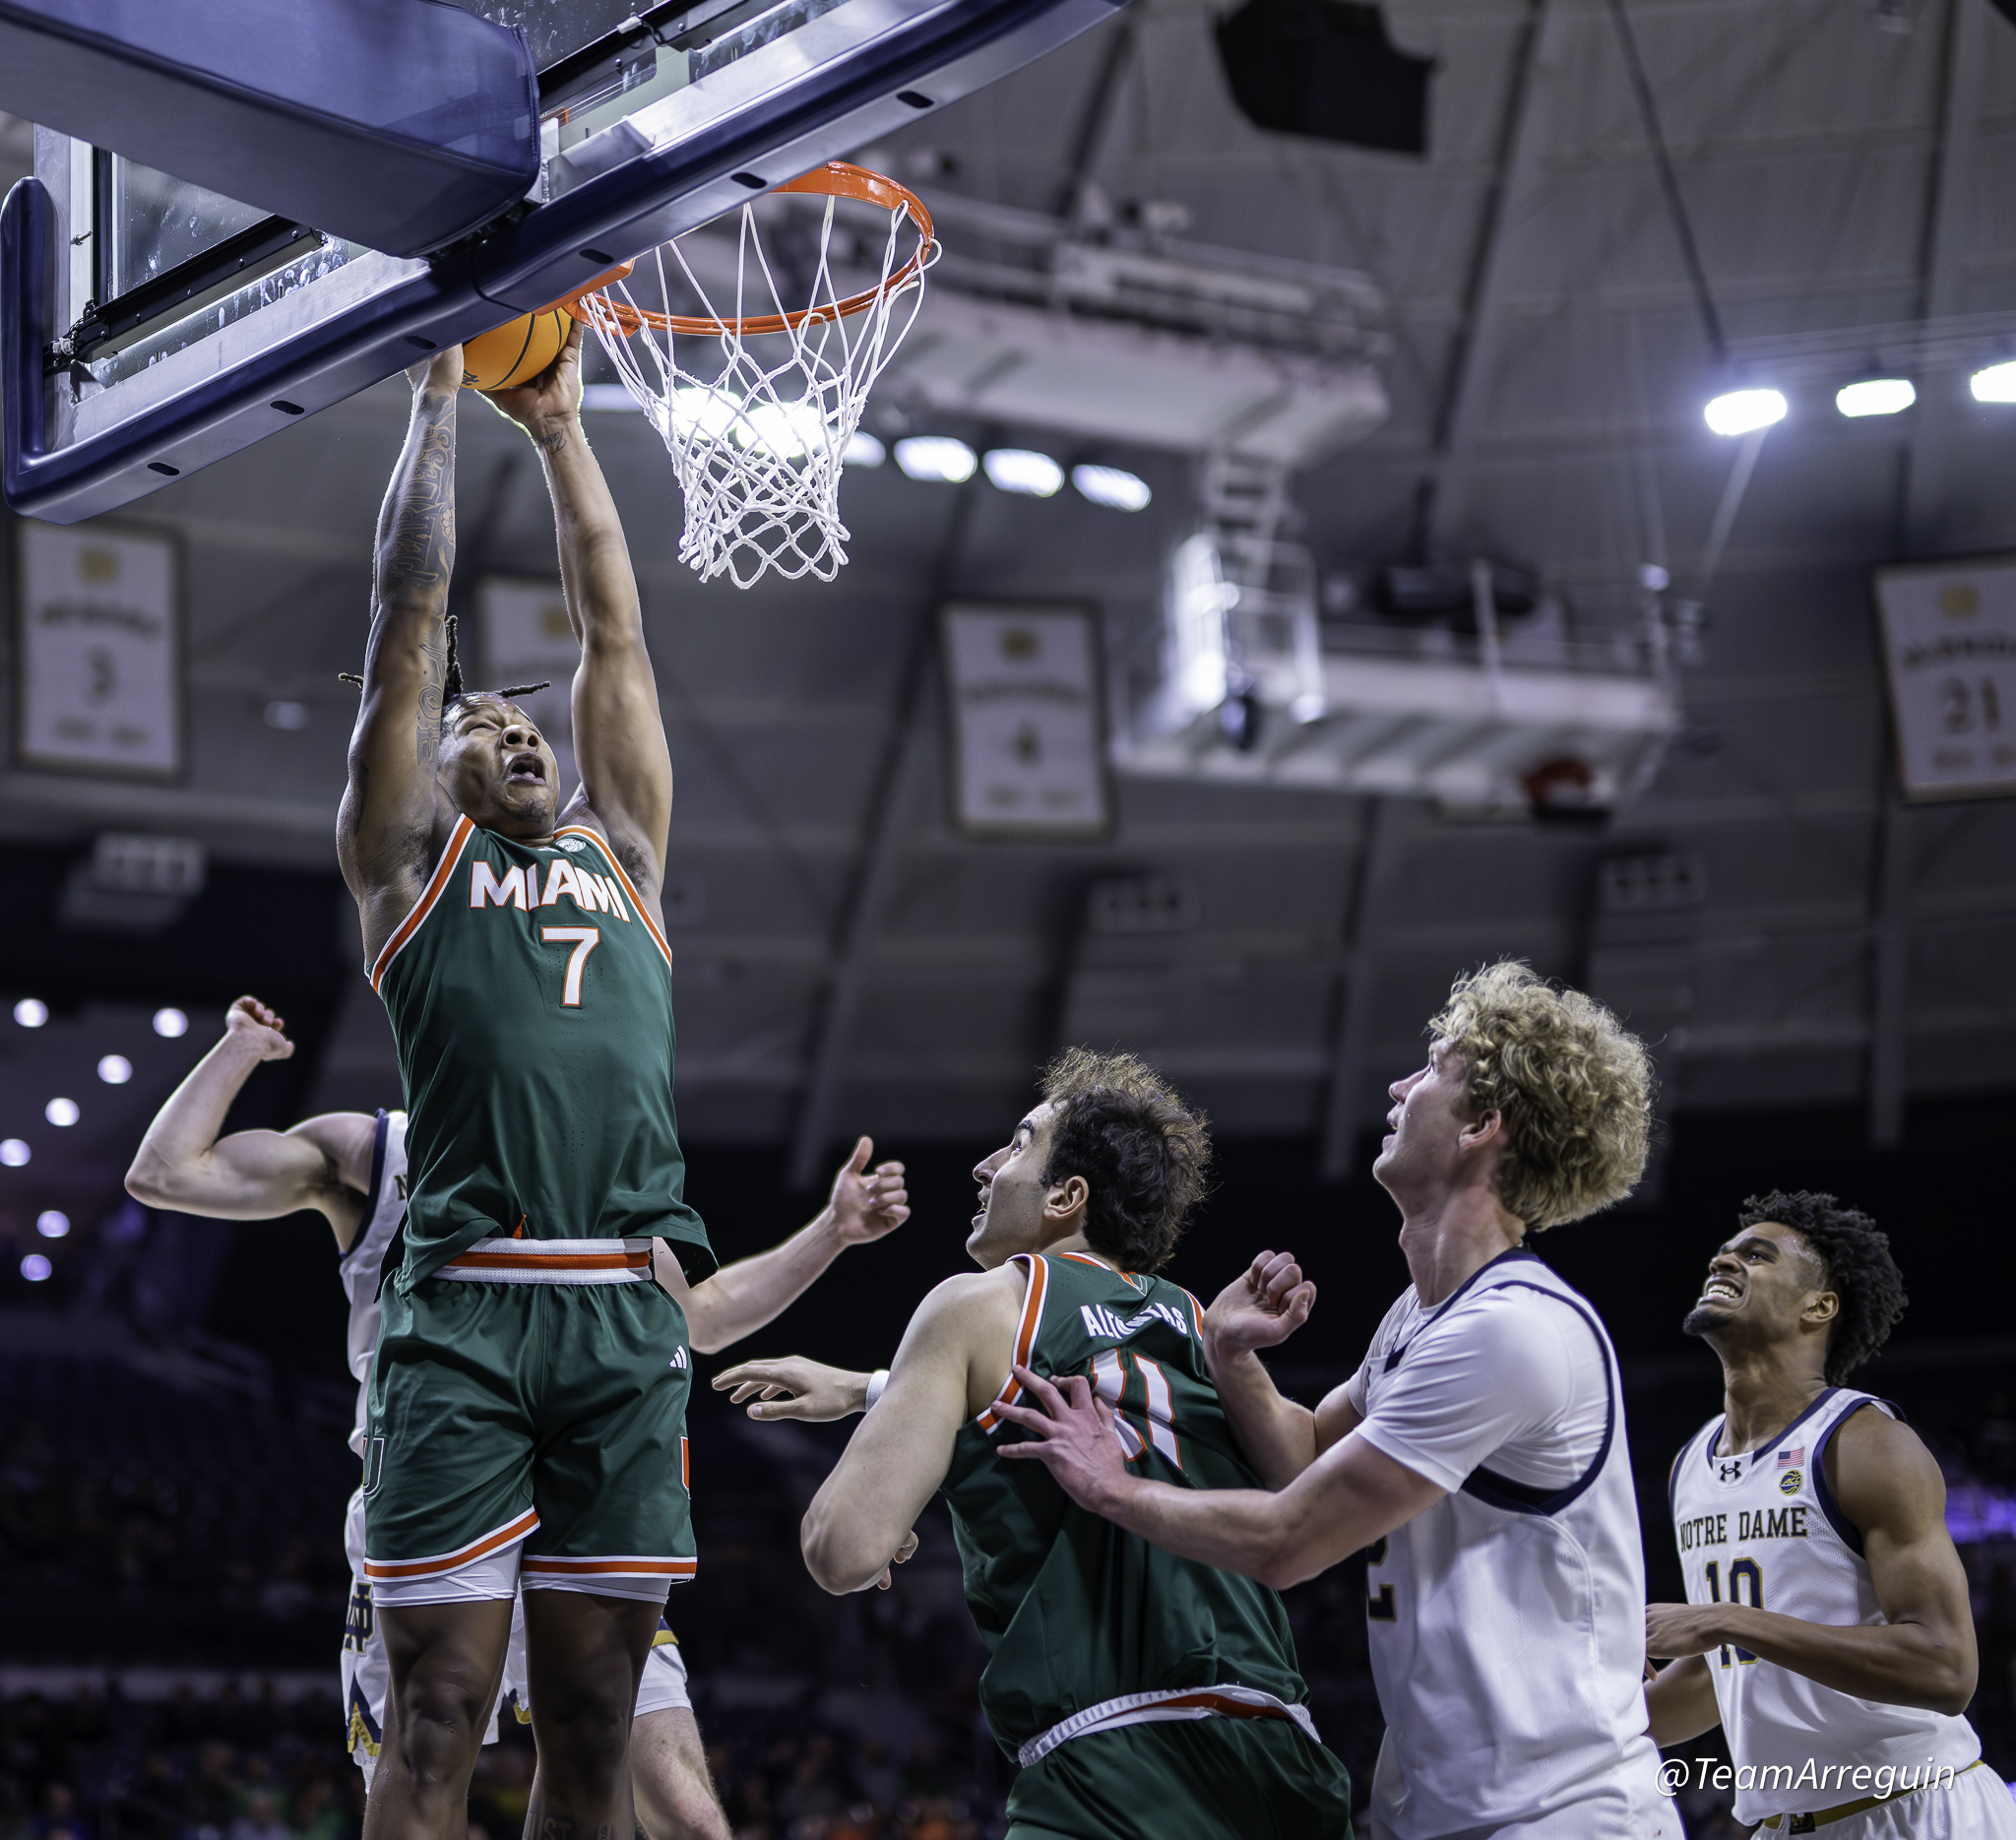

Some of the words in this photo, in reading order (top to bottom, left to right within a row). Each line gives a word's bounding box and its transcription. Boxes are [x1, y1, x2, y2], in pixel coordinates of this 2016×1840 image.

[469, 858, 632, 924] MIAMI
[540, 925, 600, 1007] 7
[1090, 1346, 1183, 1471] 11
[1679, 1513, 1728, 1554] NOTRE
[1738, 1506, 1808, 1542] DAME
